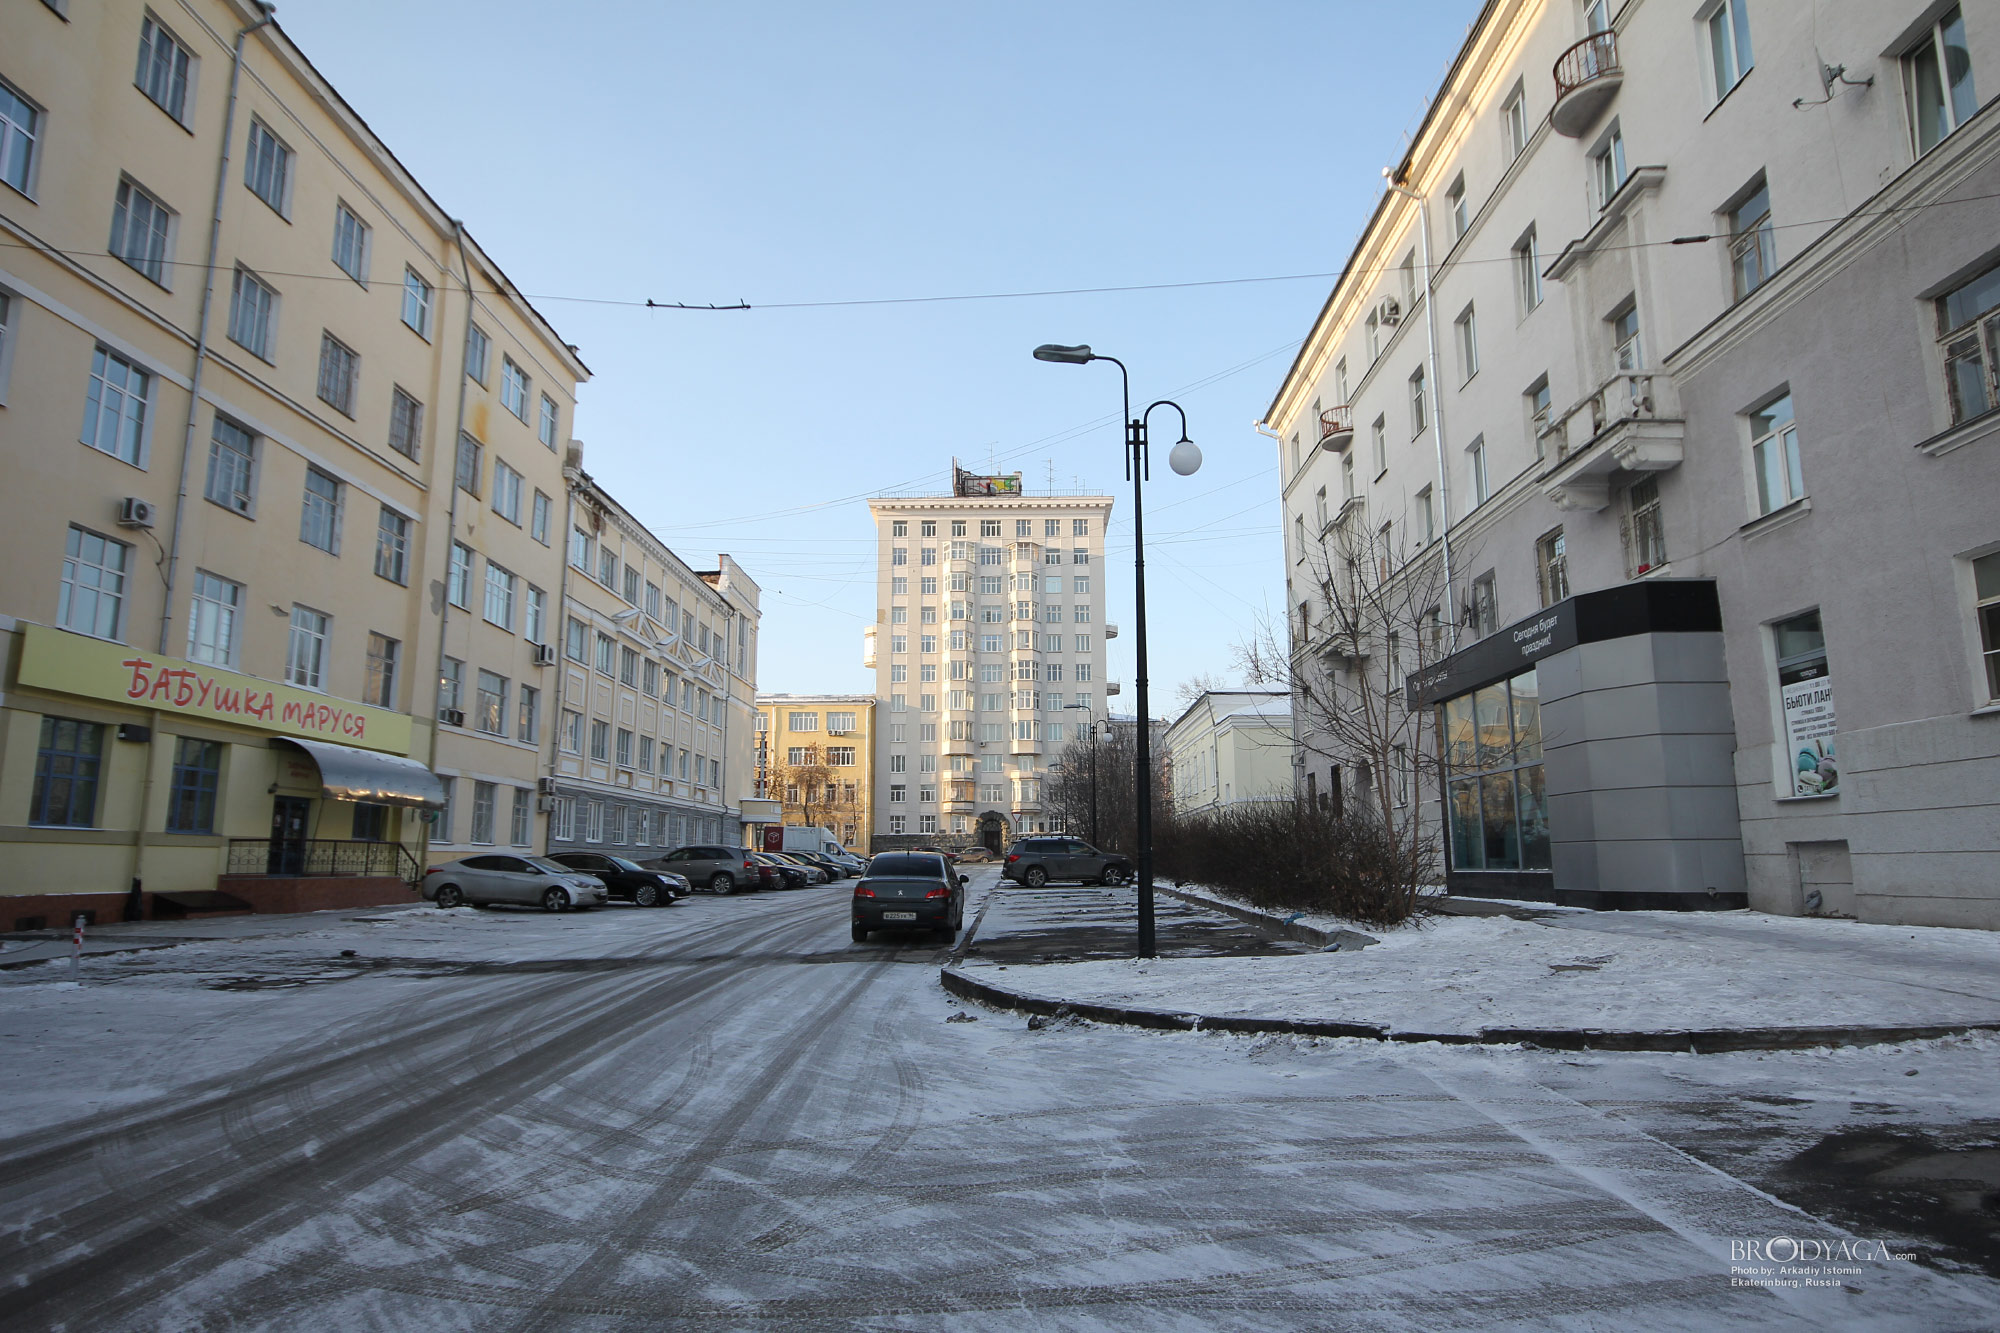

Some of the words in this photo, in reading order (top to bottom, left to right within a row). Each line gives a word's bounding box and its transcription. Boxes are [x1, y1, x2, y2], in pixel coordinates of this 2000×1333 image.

[1513, 626, 1540, 643] Сегодня
[1539, 615, 1558, 633] будет
[1521, 632, 1552, 657] праздник!
[122, 657, 274, 721] БАБУШКА
[1786, 692, 1813, 710] БЬЮТИ
